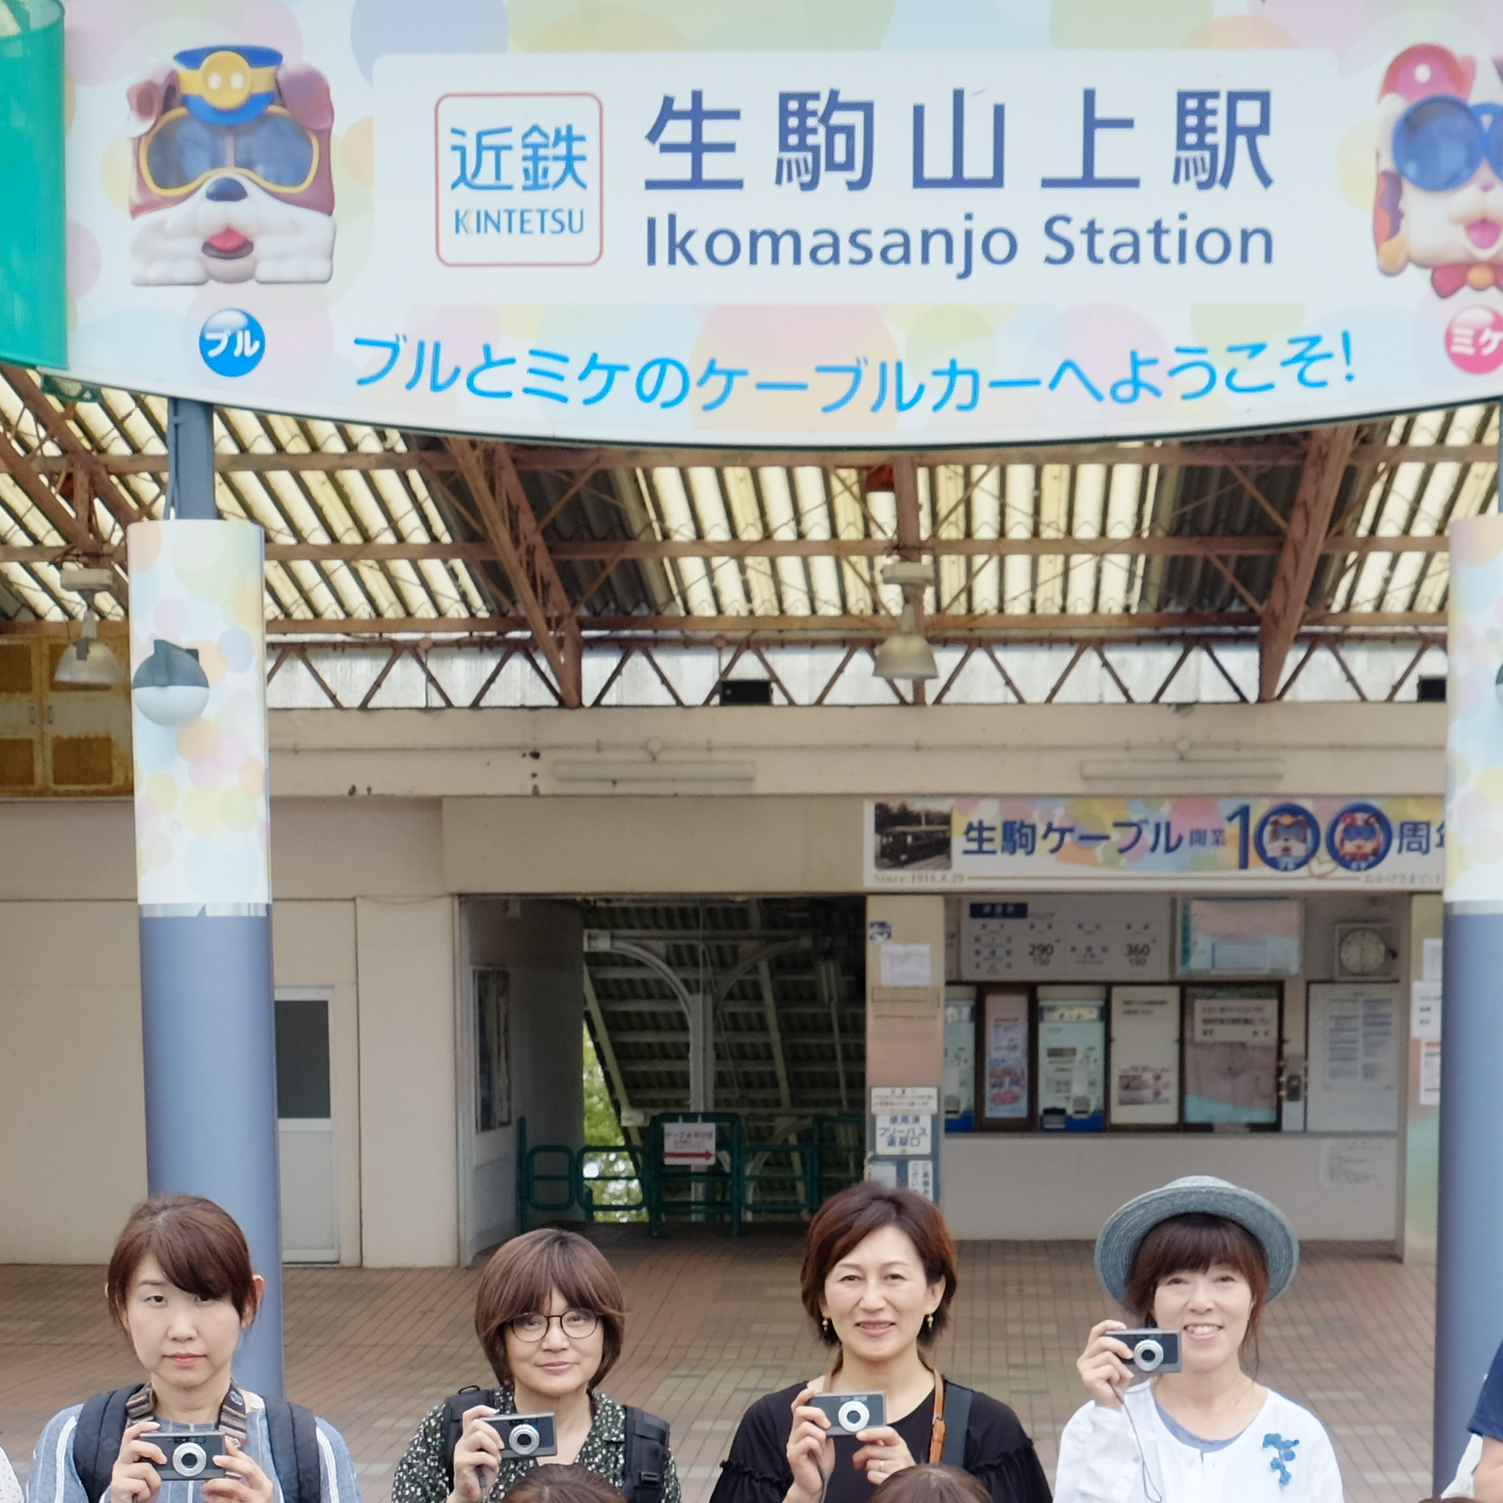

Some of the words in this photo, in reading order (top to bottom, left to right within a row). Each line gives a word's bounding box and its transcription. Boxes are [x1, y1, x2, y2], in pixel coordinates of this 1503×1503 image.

[450, 124, 588, 192] 近鉄
[644, 88, 1274, 192] 生駒山上駅
[454, 208, 585, 235] KINTETSU
[646, 212, 1019, 281] Ikomasanjo
[1043, 212, 1274, 266] Station
[204, 328, 261, 358] ブル
[354, 331, 1355, 413] ブルとミケのケーブルカーへようこそ!
